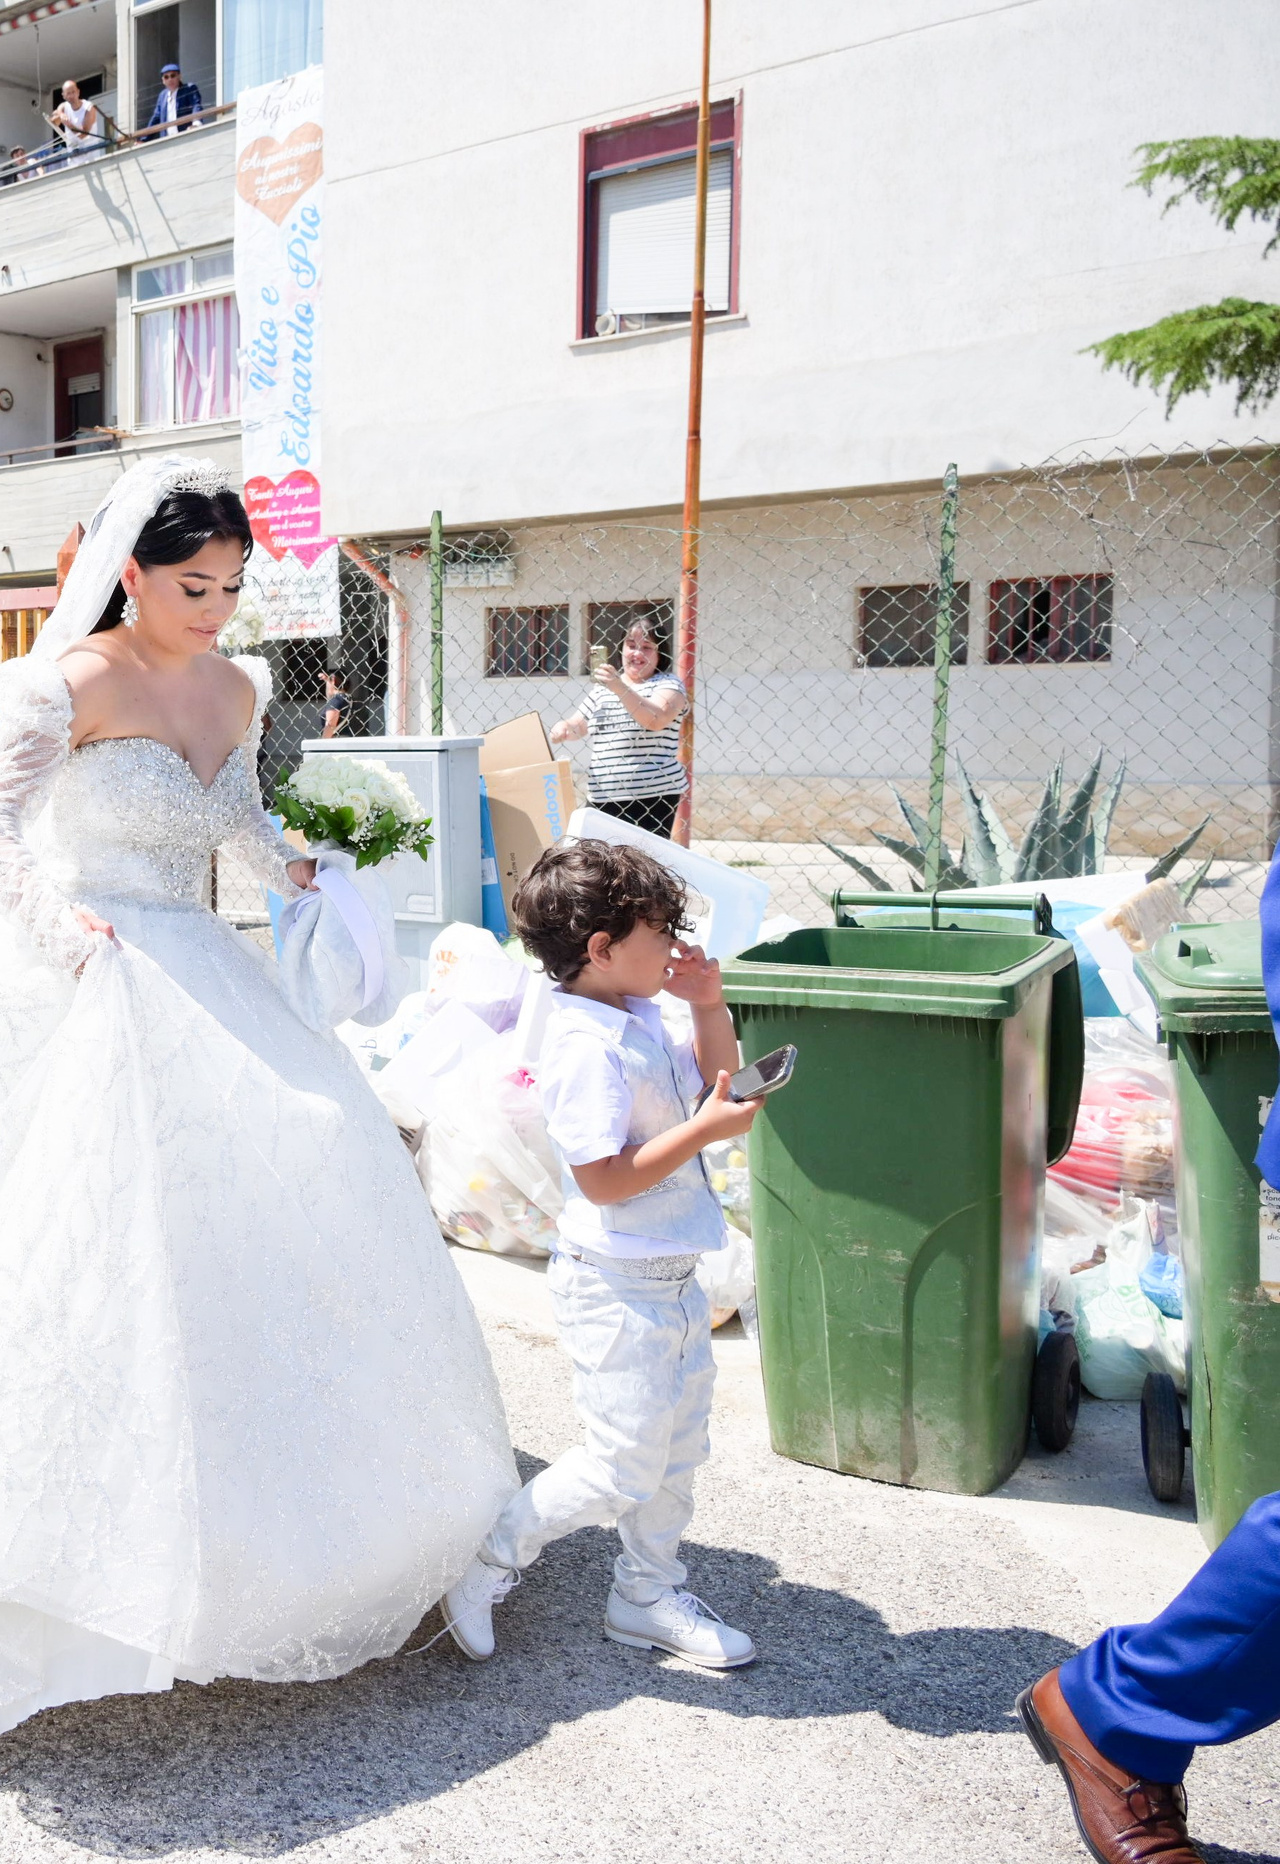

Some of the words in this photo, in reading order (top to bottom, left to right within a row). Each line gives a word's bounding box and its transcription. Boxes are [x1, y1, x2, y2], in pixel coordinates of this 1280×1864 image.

[287, 203, 321, 288] Pio
[259, 285, 280, 306] e
[246, 318, 280, 391] Vito
[277, 300, 313, 466] Edoardo
[276, 483, 314, 500] Auguri
